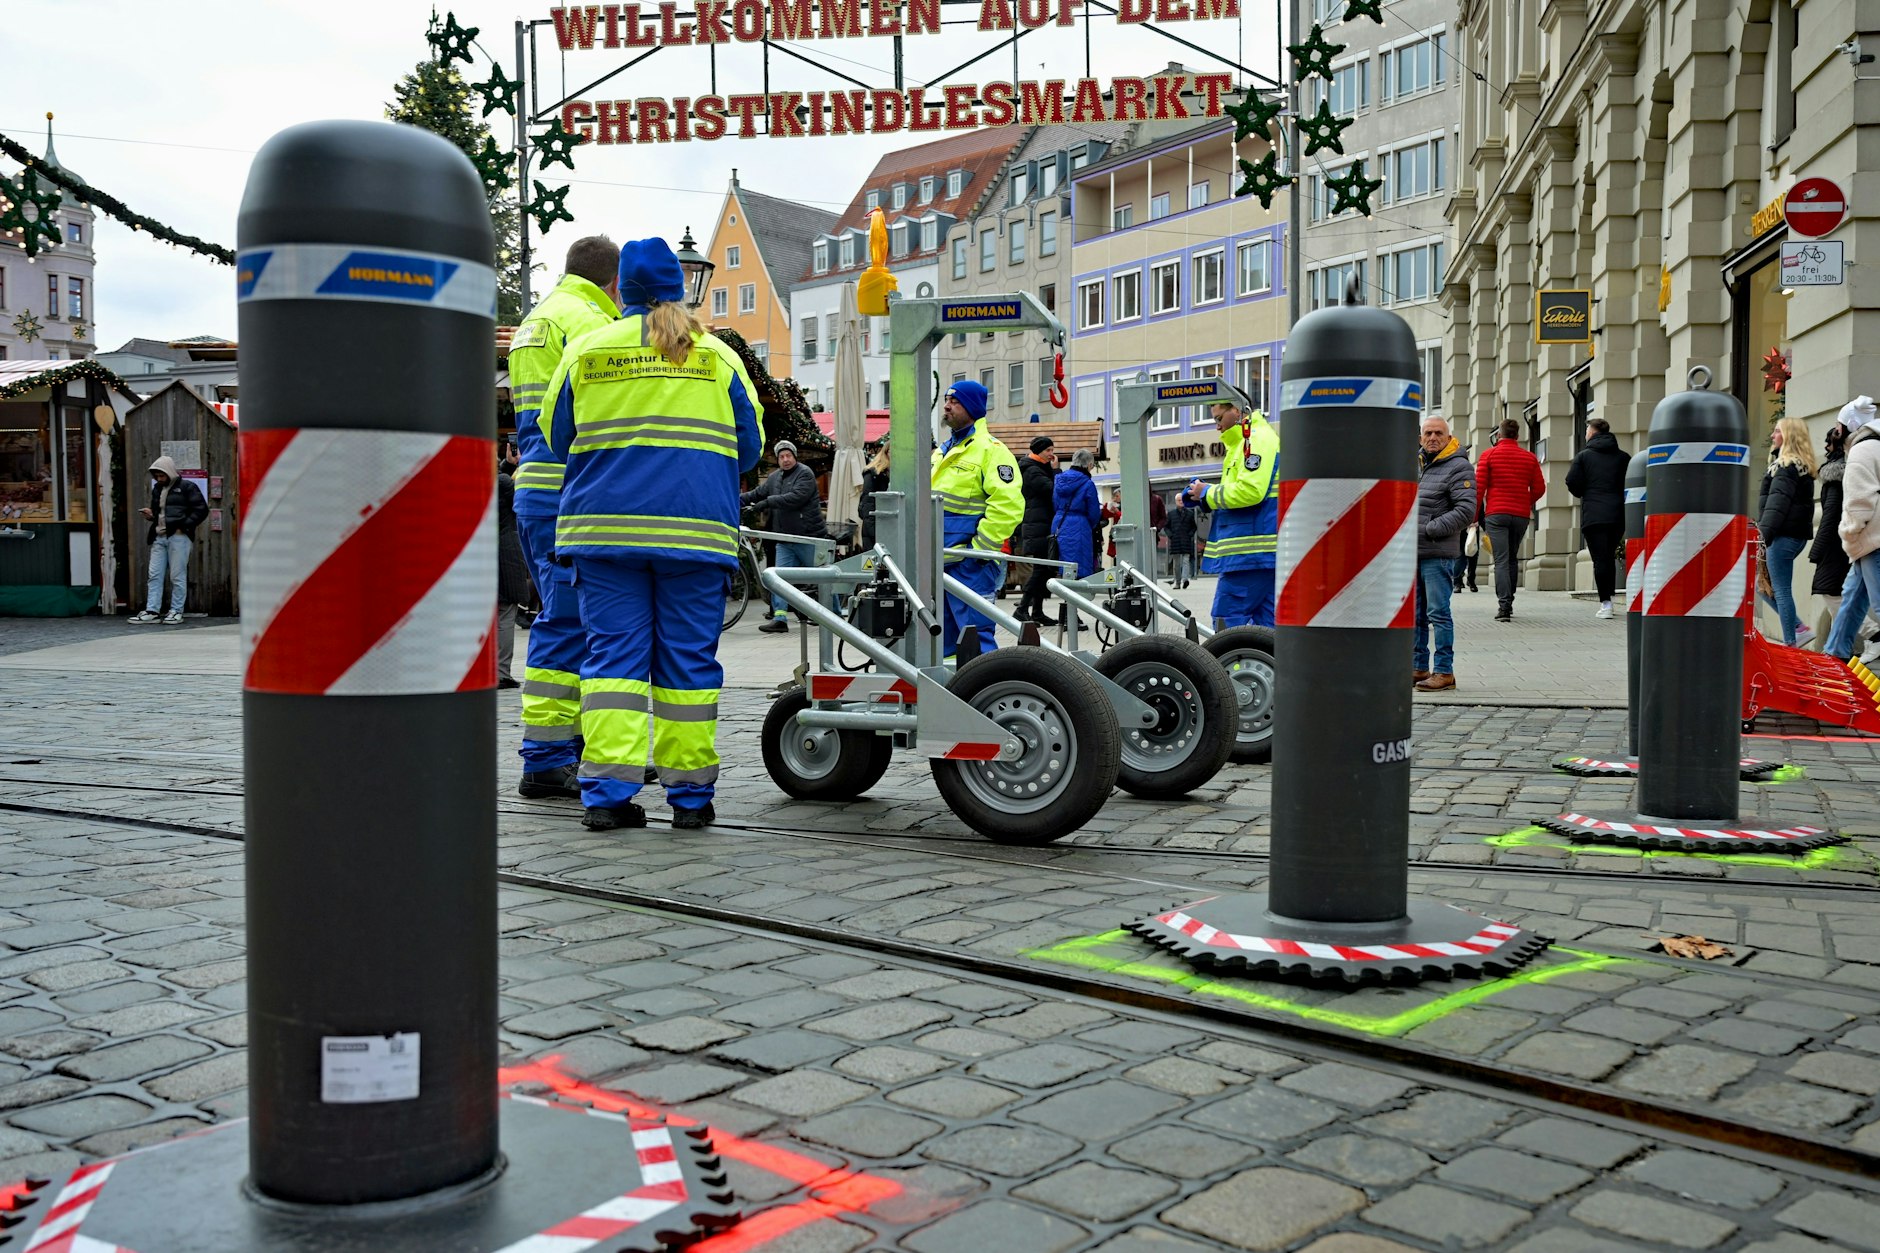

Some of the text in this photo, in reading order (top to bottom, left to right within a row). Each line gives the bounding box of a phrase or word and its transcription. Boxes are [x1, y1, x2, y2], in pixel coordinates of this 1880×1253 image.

[551, 0, 941, 50] WILLKOMMEN
[977, 0, 1084, 31] AUF
[561, 72, 1233, 146] CHRISTKINDLESMARKT
[1751, 192, 1786, 238] HERREN
[1785, 275, 1807, 283] 20:30
[1814, 274, 1837, 282] 11:30h
[1802, 264, 1819, 274] frei
[947, 304, 1016, 318] HÖRMANN
[1543, 305, 1585, 324] Eckerle
[607, 354, 658, 367] Agentur
[1159, 442, 1205, 463] HENRY'S
